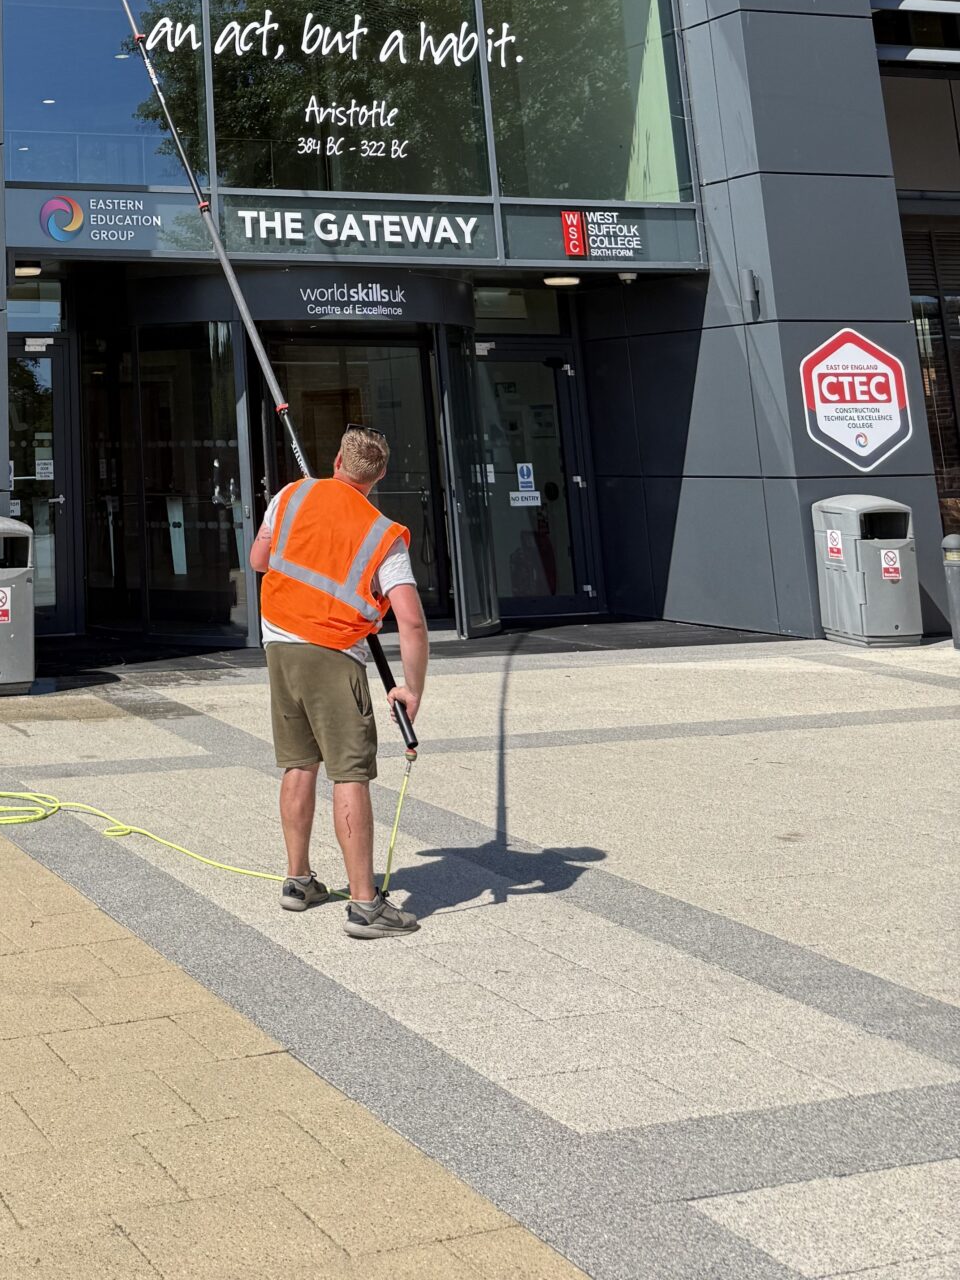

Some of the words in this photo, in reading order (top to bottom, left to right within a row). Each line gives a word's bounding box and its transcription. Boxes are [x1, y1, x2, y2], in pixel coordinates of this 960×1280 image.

[146, 17, 202, 52] an
[214, 9, 284, 59] act,
[301, 12, 368, 60] but
[379, 29, 407, 64] a
[419, 21, 523, 68] habit.
[305, 95, 398, 128] Aristotle
[297, 137, 320, 154] 384
[326, 136, 344, 155] BC
[360, 140, 386, 157] 322
[391, 140, 409, 158] BC
[89, 199, 143, 210] EASTERN
[90, 214, 161, 226] EDUCATION
[586, 211, 619, 223] WEST
[238, 210, 304, 239] THE
[314, 212, 477, 244] GATEWAY
[587, 224, 639, 236] SUFFOLK
[90, 230, 135, 240] GROUP
[589, 236, 642, 248] COLLEGE
[590, 249, 611, 257] SIXTH
[612, 249, 633, 257] FORM
[307, 304, 341, 314] Centre
[343, 304, 353, 314] of
[356, 304, 402, 315] Excellence
[821, 375, 888, 401] CTEC
